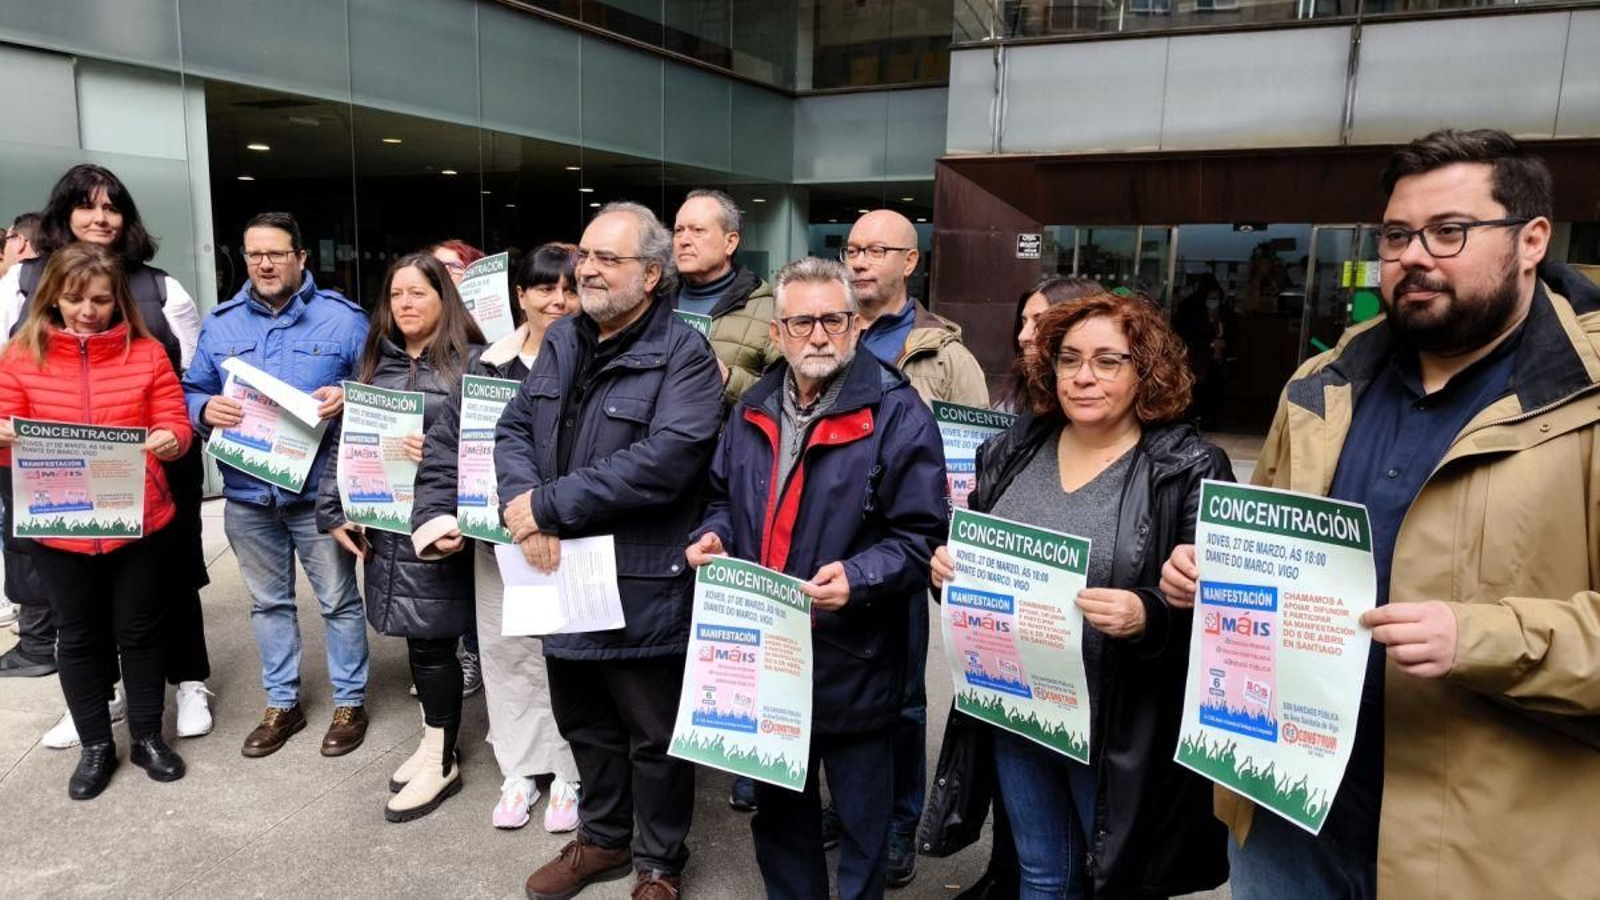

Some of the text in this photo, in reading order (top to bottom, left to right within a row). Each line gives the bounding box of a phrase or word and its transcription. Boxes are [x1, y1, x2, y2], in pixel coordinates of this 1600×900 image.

[348, 388, 417, 411] CONCENTRACIÓN
[21, 424, 139, 441] CONCENTRACIÓN
[1209, 495, 1361, 543] CONCENTRACIÓN
[958, 520, 1080, 568] CONCENTRACIÓN
[1207, 532, 1231, 550] XOVES,
[1233, 538, 1242, 550] 27
[1243, 540, 1254, 552] DE
[1256, 542, 1287, 560] MARZO,
[1304, 550, 1326, 567] 18:00
[978, 555, 986, 566] 27
[986, 557, 995, 569] DE
[996, 559, 1021, 577] MARZO,
[1205, 549, 1299, 580] DIANTE DO MARCO, VIGO
[707, 564, 805, 608] CONCENTRACIÓN
[955, 561, 976, 577] DIANTE
[976, 568, 986, 580] DO
[1013, 579, 1030, 592] VIGO
[735, 596, 744, 606] DE
[951, 590, 1010, 610] MANIFESTACIÓN
[1203, 587, 1272, 607] MANIFESTACIÓN
[1283, 592, 1344, 606] CHAMAMOS A
[703, 601, 726, 614] DIANTE
[726, 606, 735, 616] DO
[759, 614, 774, 626] VIGO
[700, 627, 757, 643] MANIFESTACIÓN
[1283, 628, 1345, 646] DO 6 DE ABRIL
[1283, 639, 1342, 656] EN SANTIAGO
[1213, 677, 1221, 688] 6
